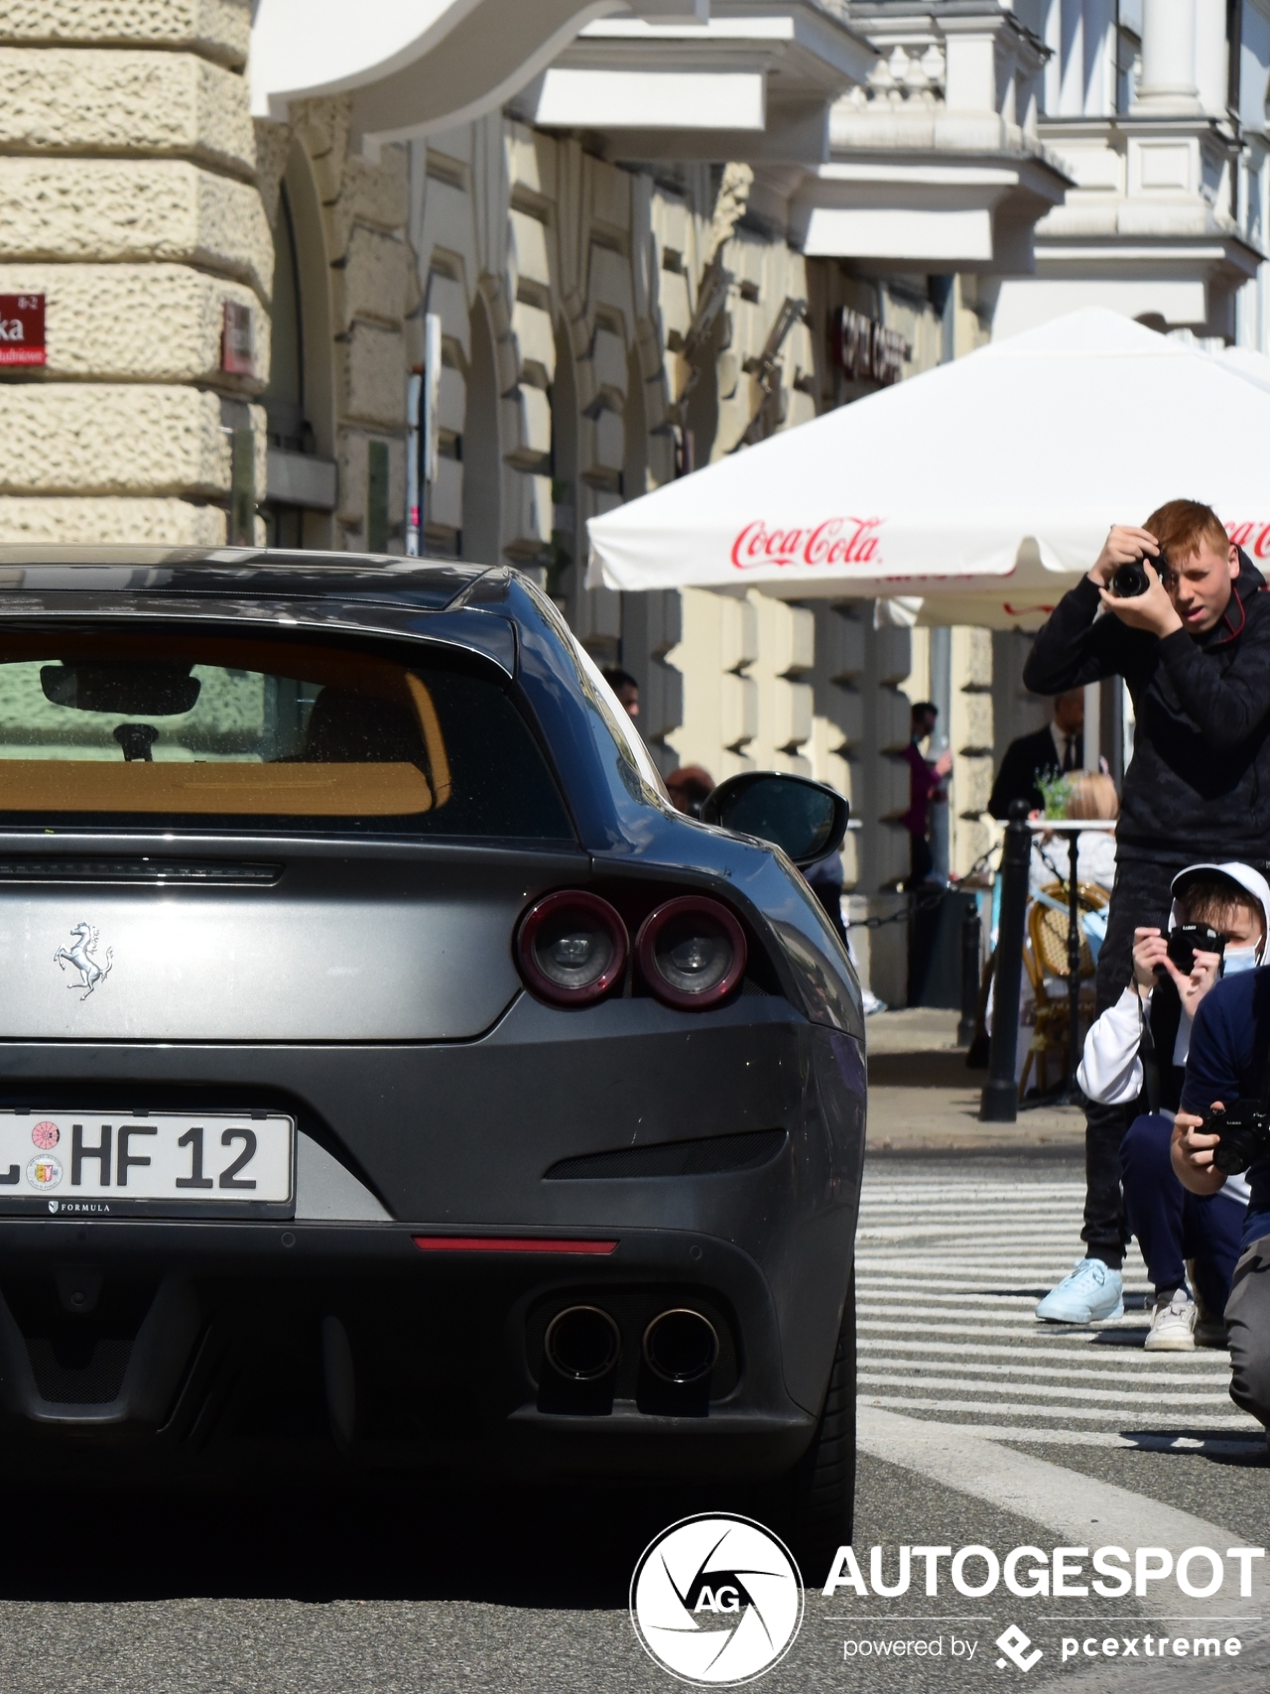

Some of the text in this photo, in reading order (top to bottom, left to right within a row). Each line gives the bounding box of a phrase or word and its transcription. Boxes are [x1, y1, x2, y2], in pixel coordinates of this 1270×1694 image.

[731, 516, 886, 570] Coca-Cola
[70, 1123, 158, 1187] HF
[175, 1126, 258, 1190] 12
[60, 1203, 111, 1213] FORMULA
